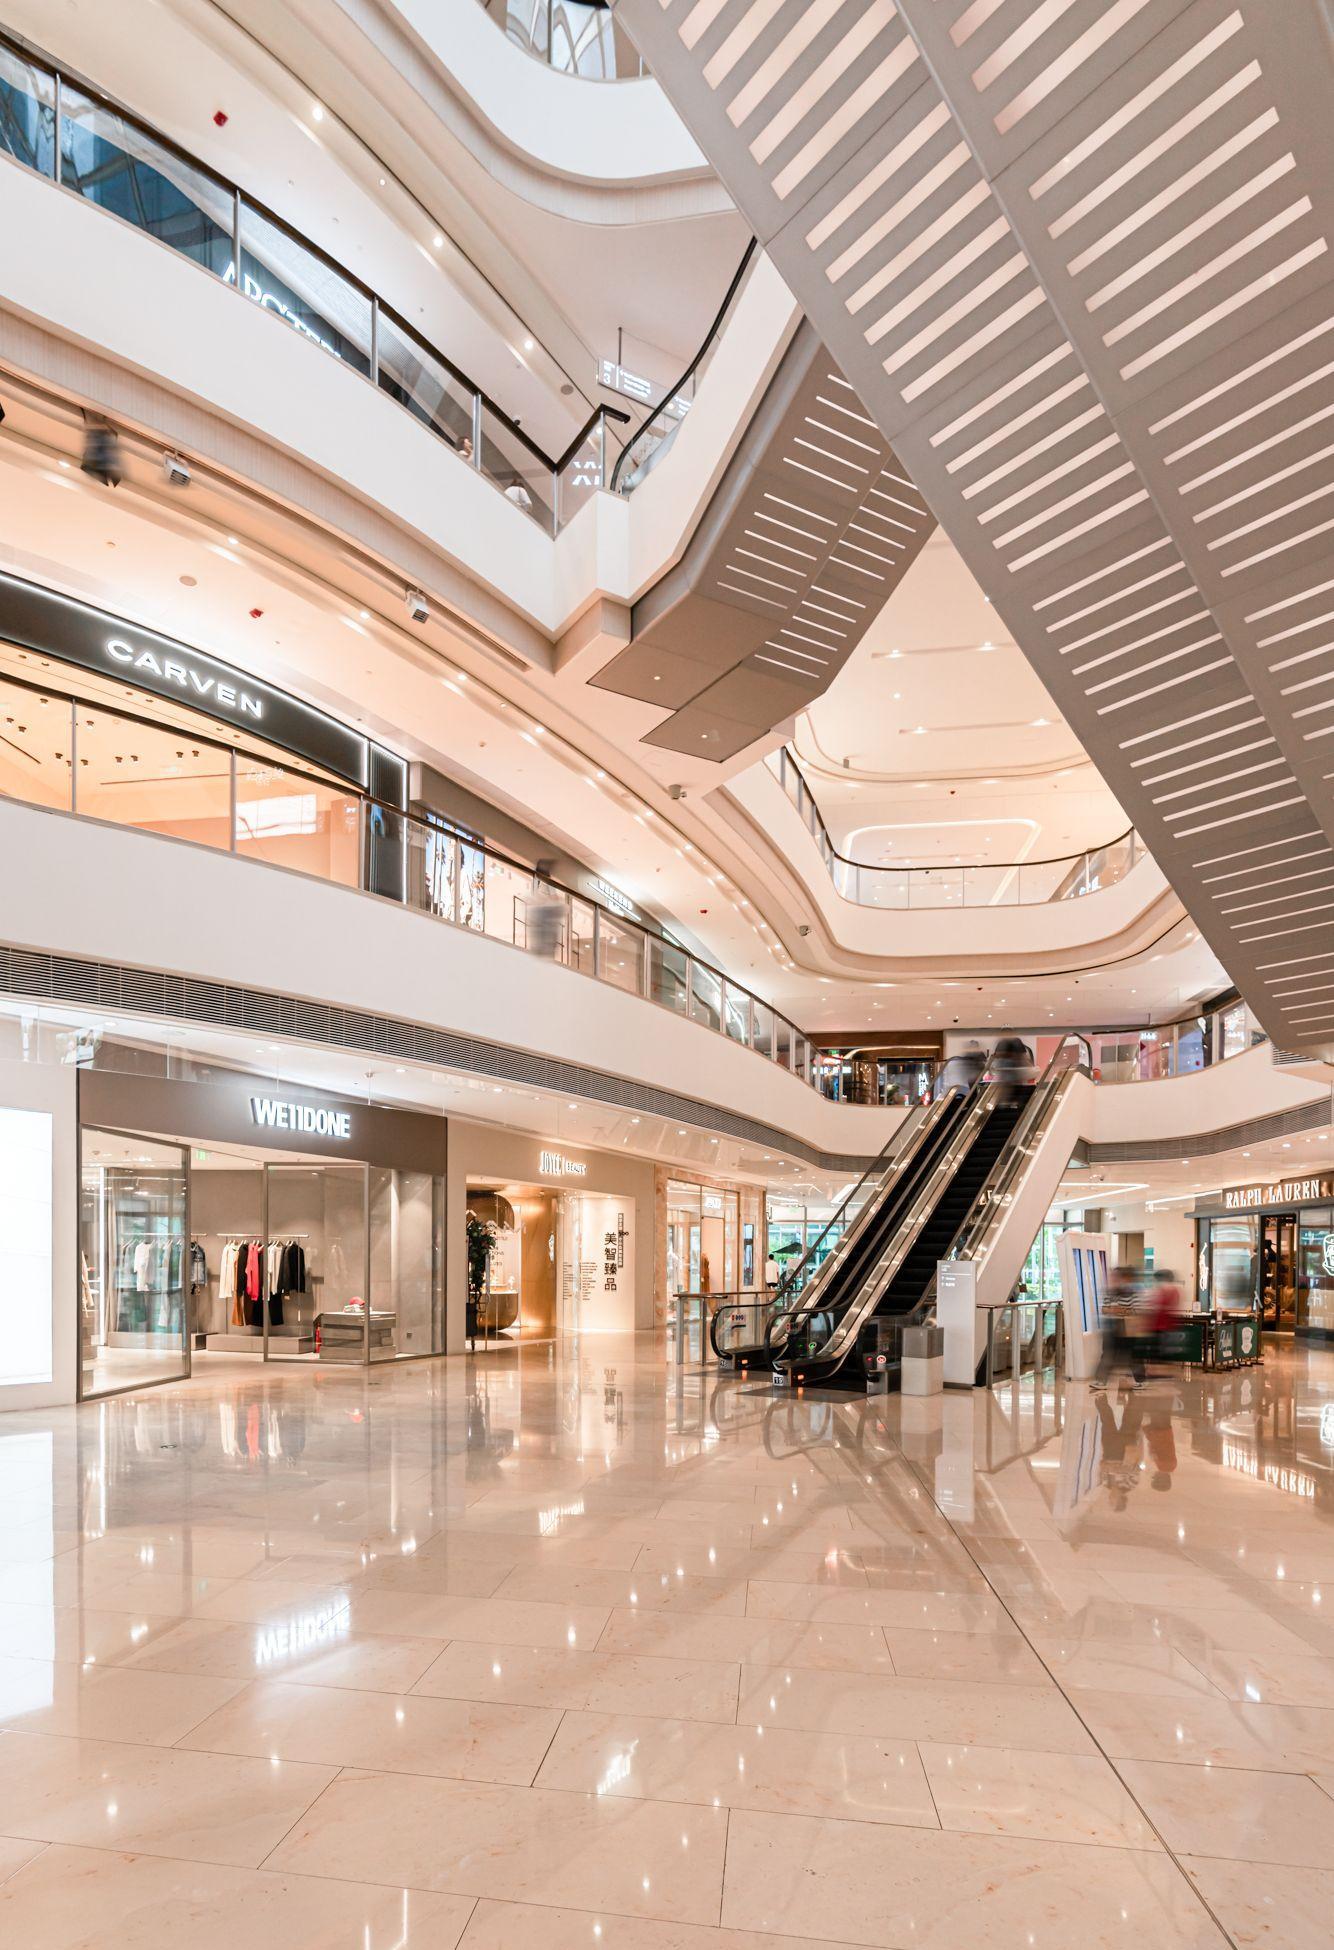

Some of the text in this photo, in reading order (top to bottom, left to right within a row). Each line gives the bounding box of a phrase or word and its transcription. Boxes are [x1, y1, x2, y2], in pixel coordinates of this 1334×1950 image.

[107, 639, 263, 719] CARVEN
[1225, 1188, 1262, 1208] RALPH
[1268, 1180, 1320, 1204] LAUREN
